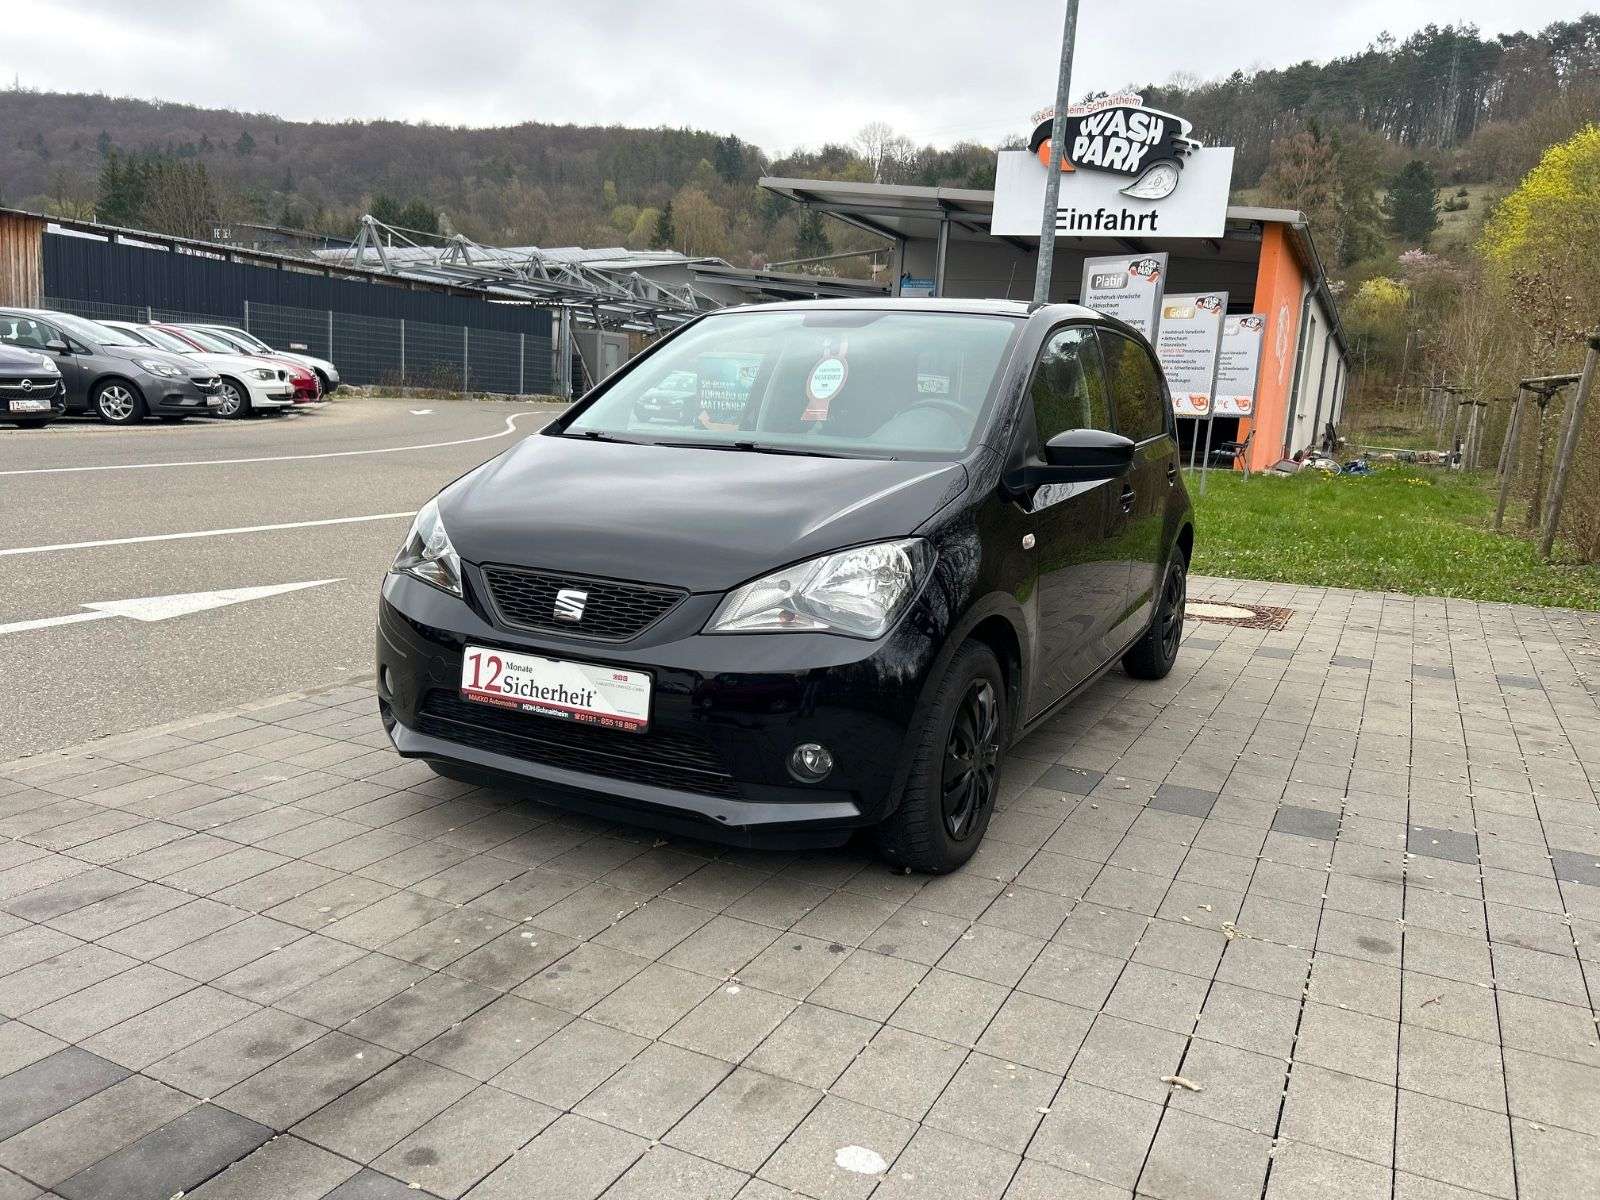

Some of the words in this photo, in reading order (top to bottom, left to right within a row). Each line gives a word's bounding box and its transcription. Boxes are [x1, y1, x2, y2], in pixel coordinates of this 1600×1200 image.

[1086, 95, 1141, 112] Schnaitheim
[1079, 110, 1164, 146] WASH
[1072, 135, 1149, 173] PARK
[1055, 208, 1159, 231] Einfahrt
[1095, 276, 1123, 288] Platin
[468, 652, 502, 692] 12
[506, 661, 533, 674] Monate
[522, 703, 569, 718] HDH-Schnaitheim
